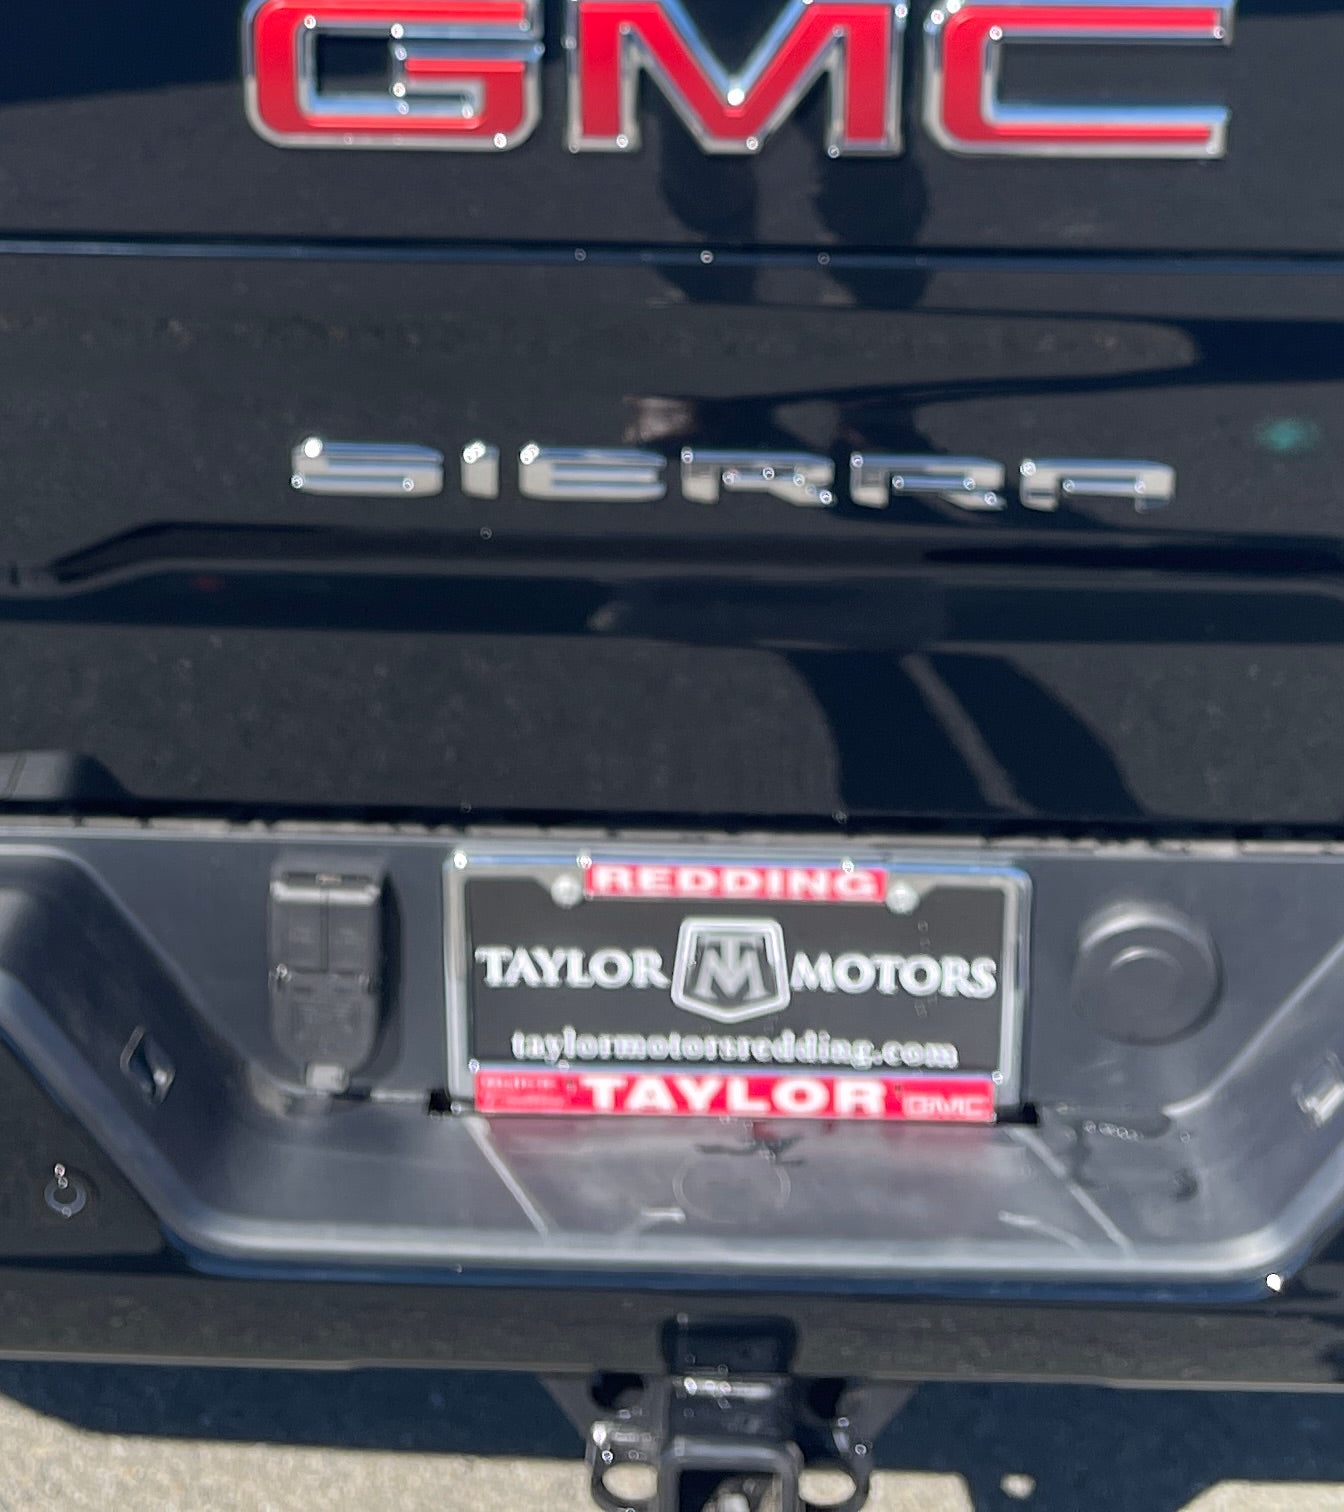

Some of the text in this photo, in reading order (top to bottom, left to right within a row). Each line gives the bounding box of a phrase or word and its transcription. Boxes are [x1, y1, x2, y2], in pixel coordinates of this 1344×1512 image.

[292, 441, 1177, 512] SIERRA
[592, 865, 878, 899] REDDING
[474, 945, 998, 999] TAYLOR MOTORS
[511, 1026, 958, 1069] taylormotorsredding.com
[578, 1076, 886, 1116] TAYLOR
